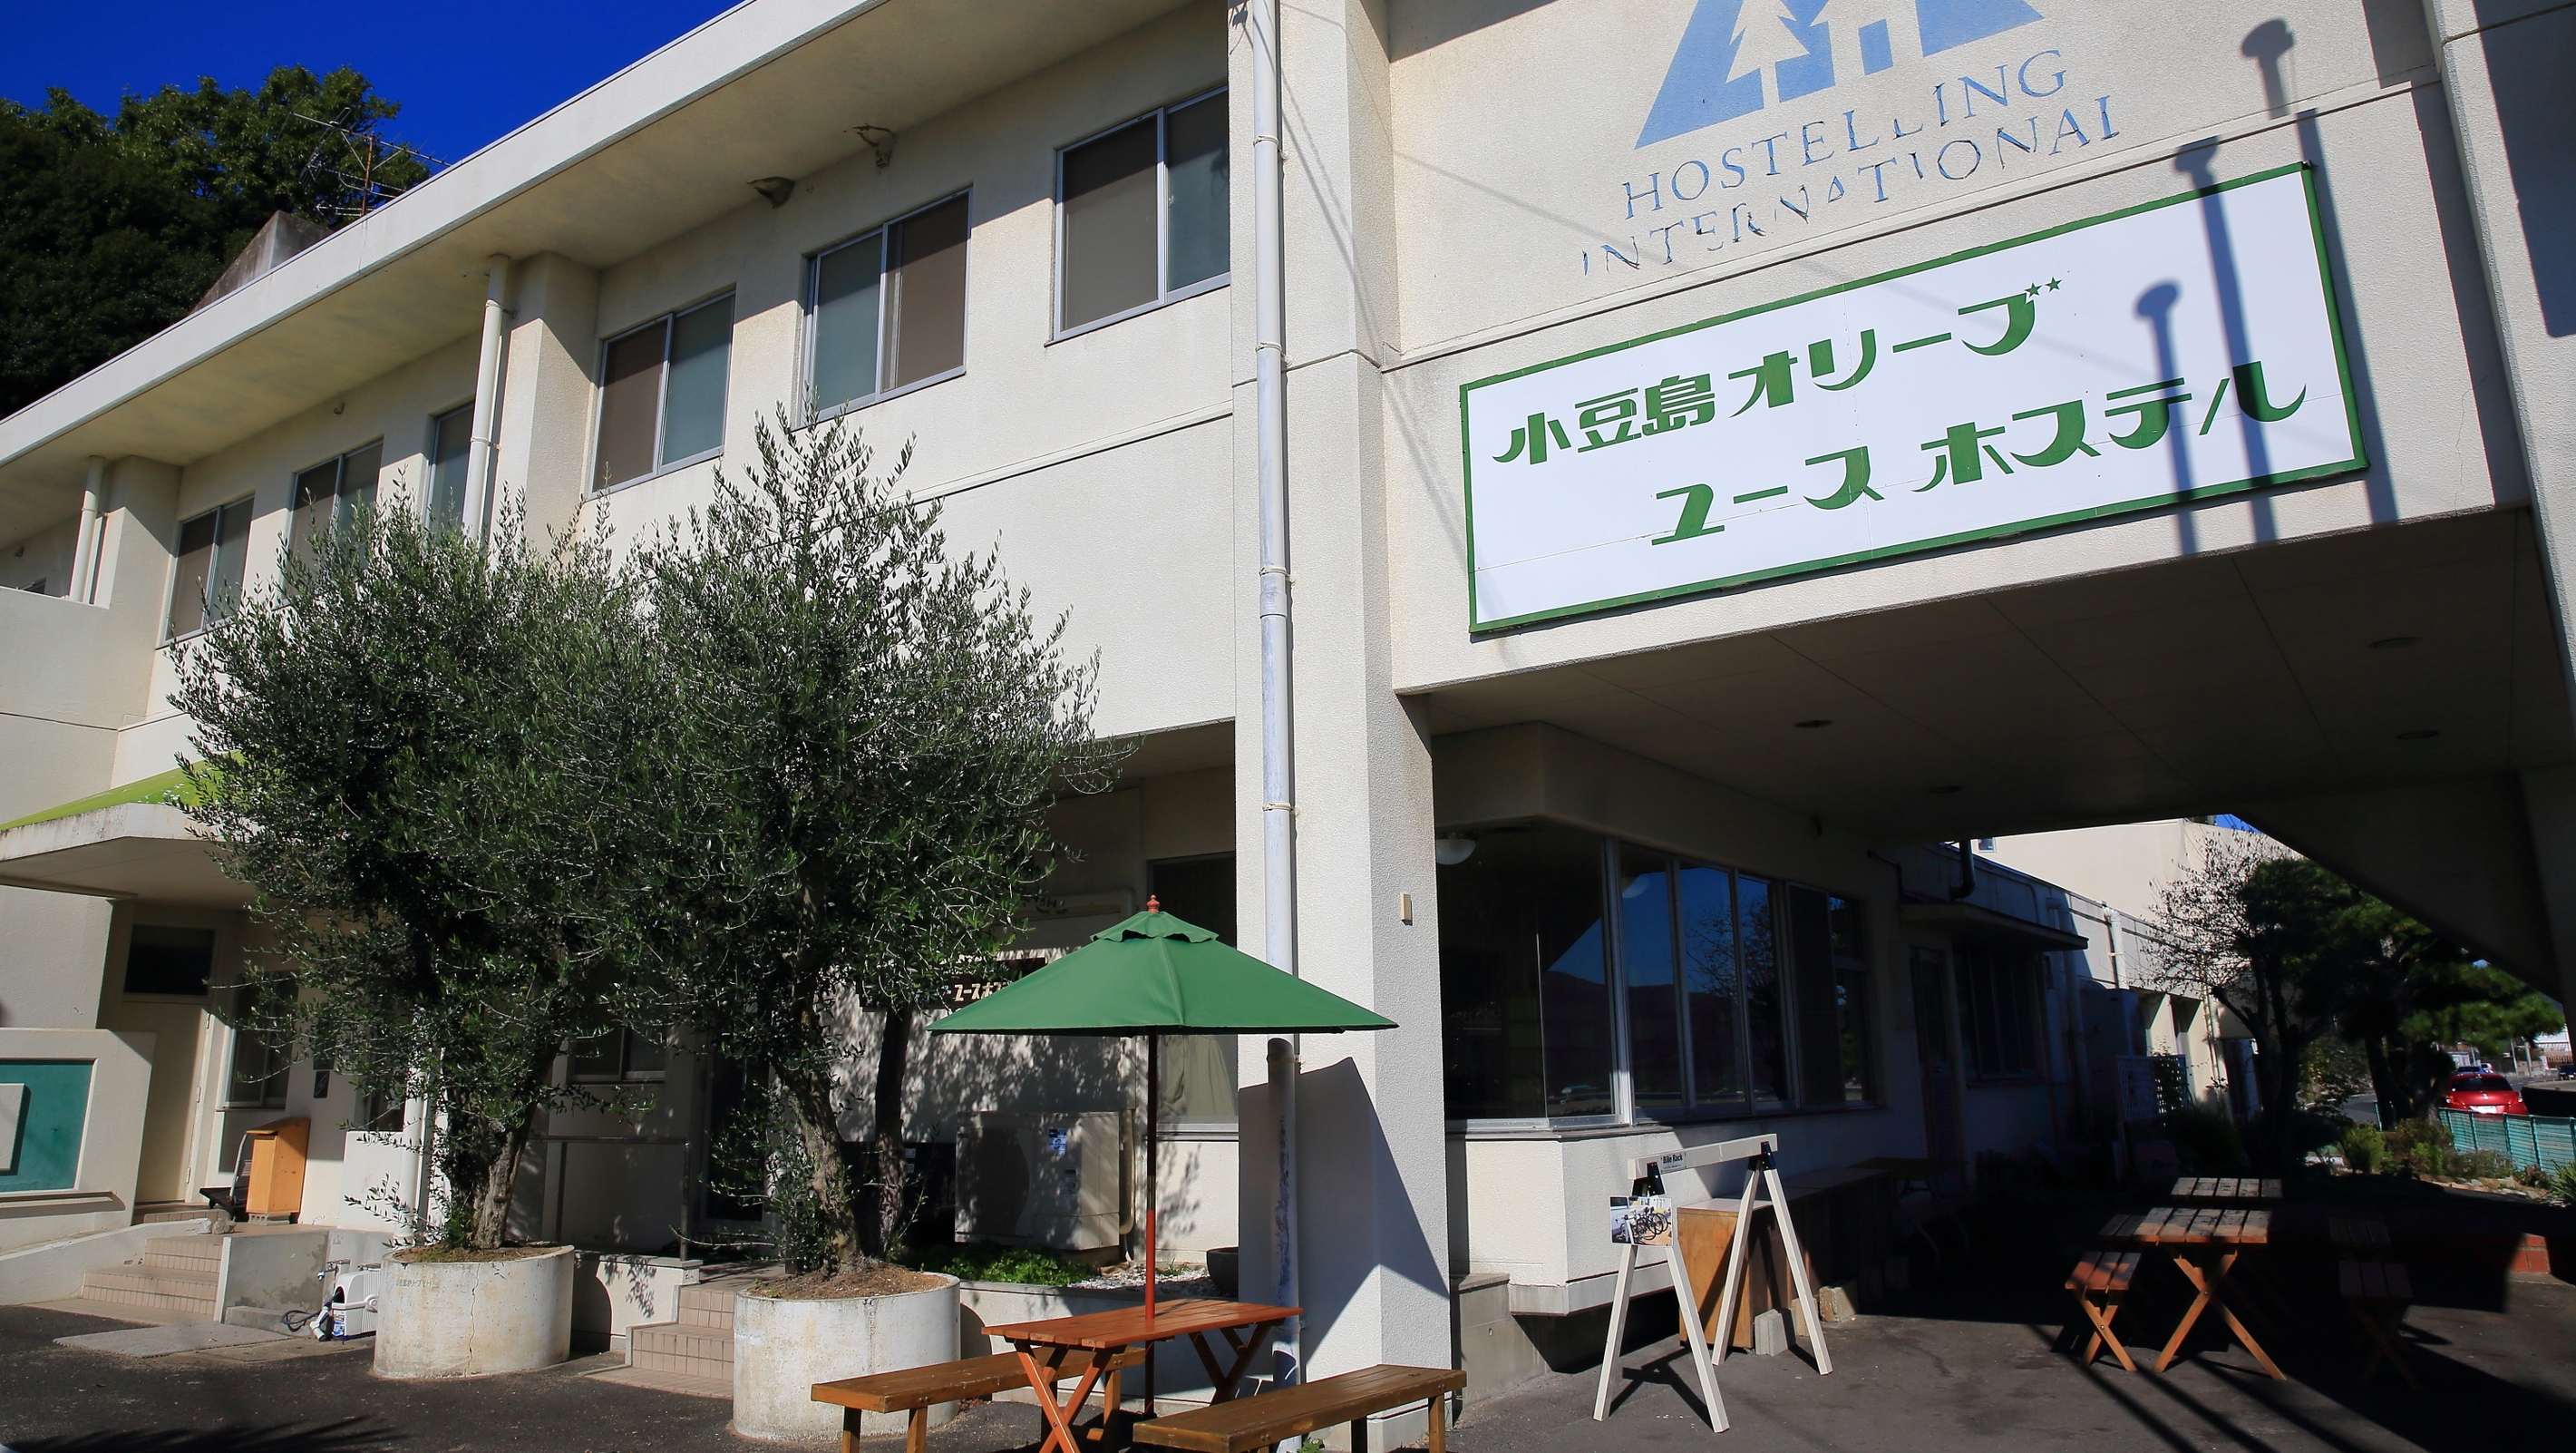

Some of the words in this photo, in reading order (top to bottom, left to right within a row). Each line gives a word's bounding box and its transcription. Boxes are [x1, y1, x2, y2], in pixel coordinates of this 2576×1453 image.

[1582, 95, 2120, 276] INTERNATIONAL
[1621, 50, 2066, 219] HOSTELLING
[1493, 277, 2063, 465] 小豆島オリーブ
[954, 981, 1007, 1002] ユースホ
[1663, 1156, 1672, 1164] Bike
[1673, 1153, 1683, 1162] Rack
